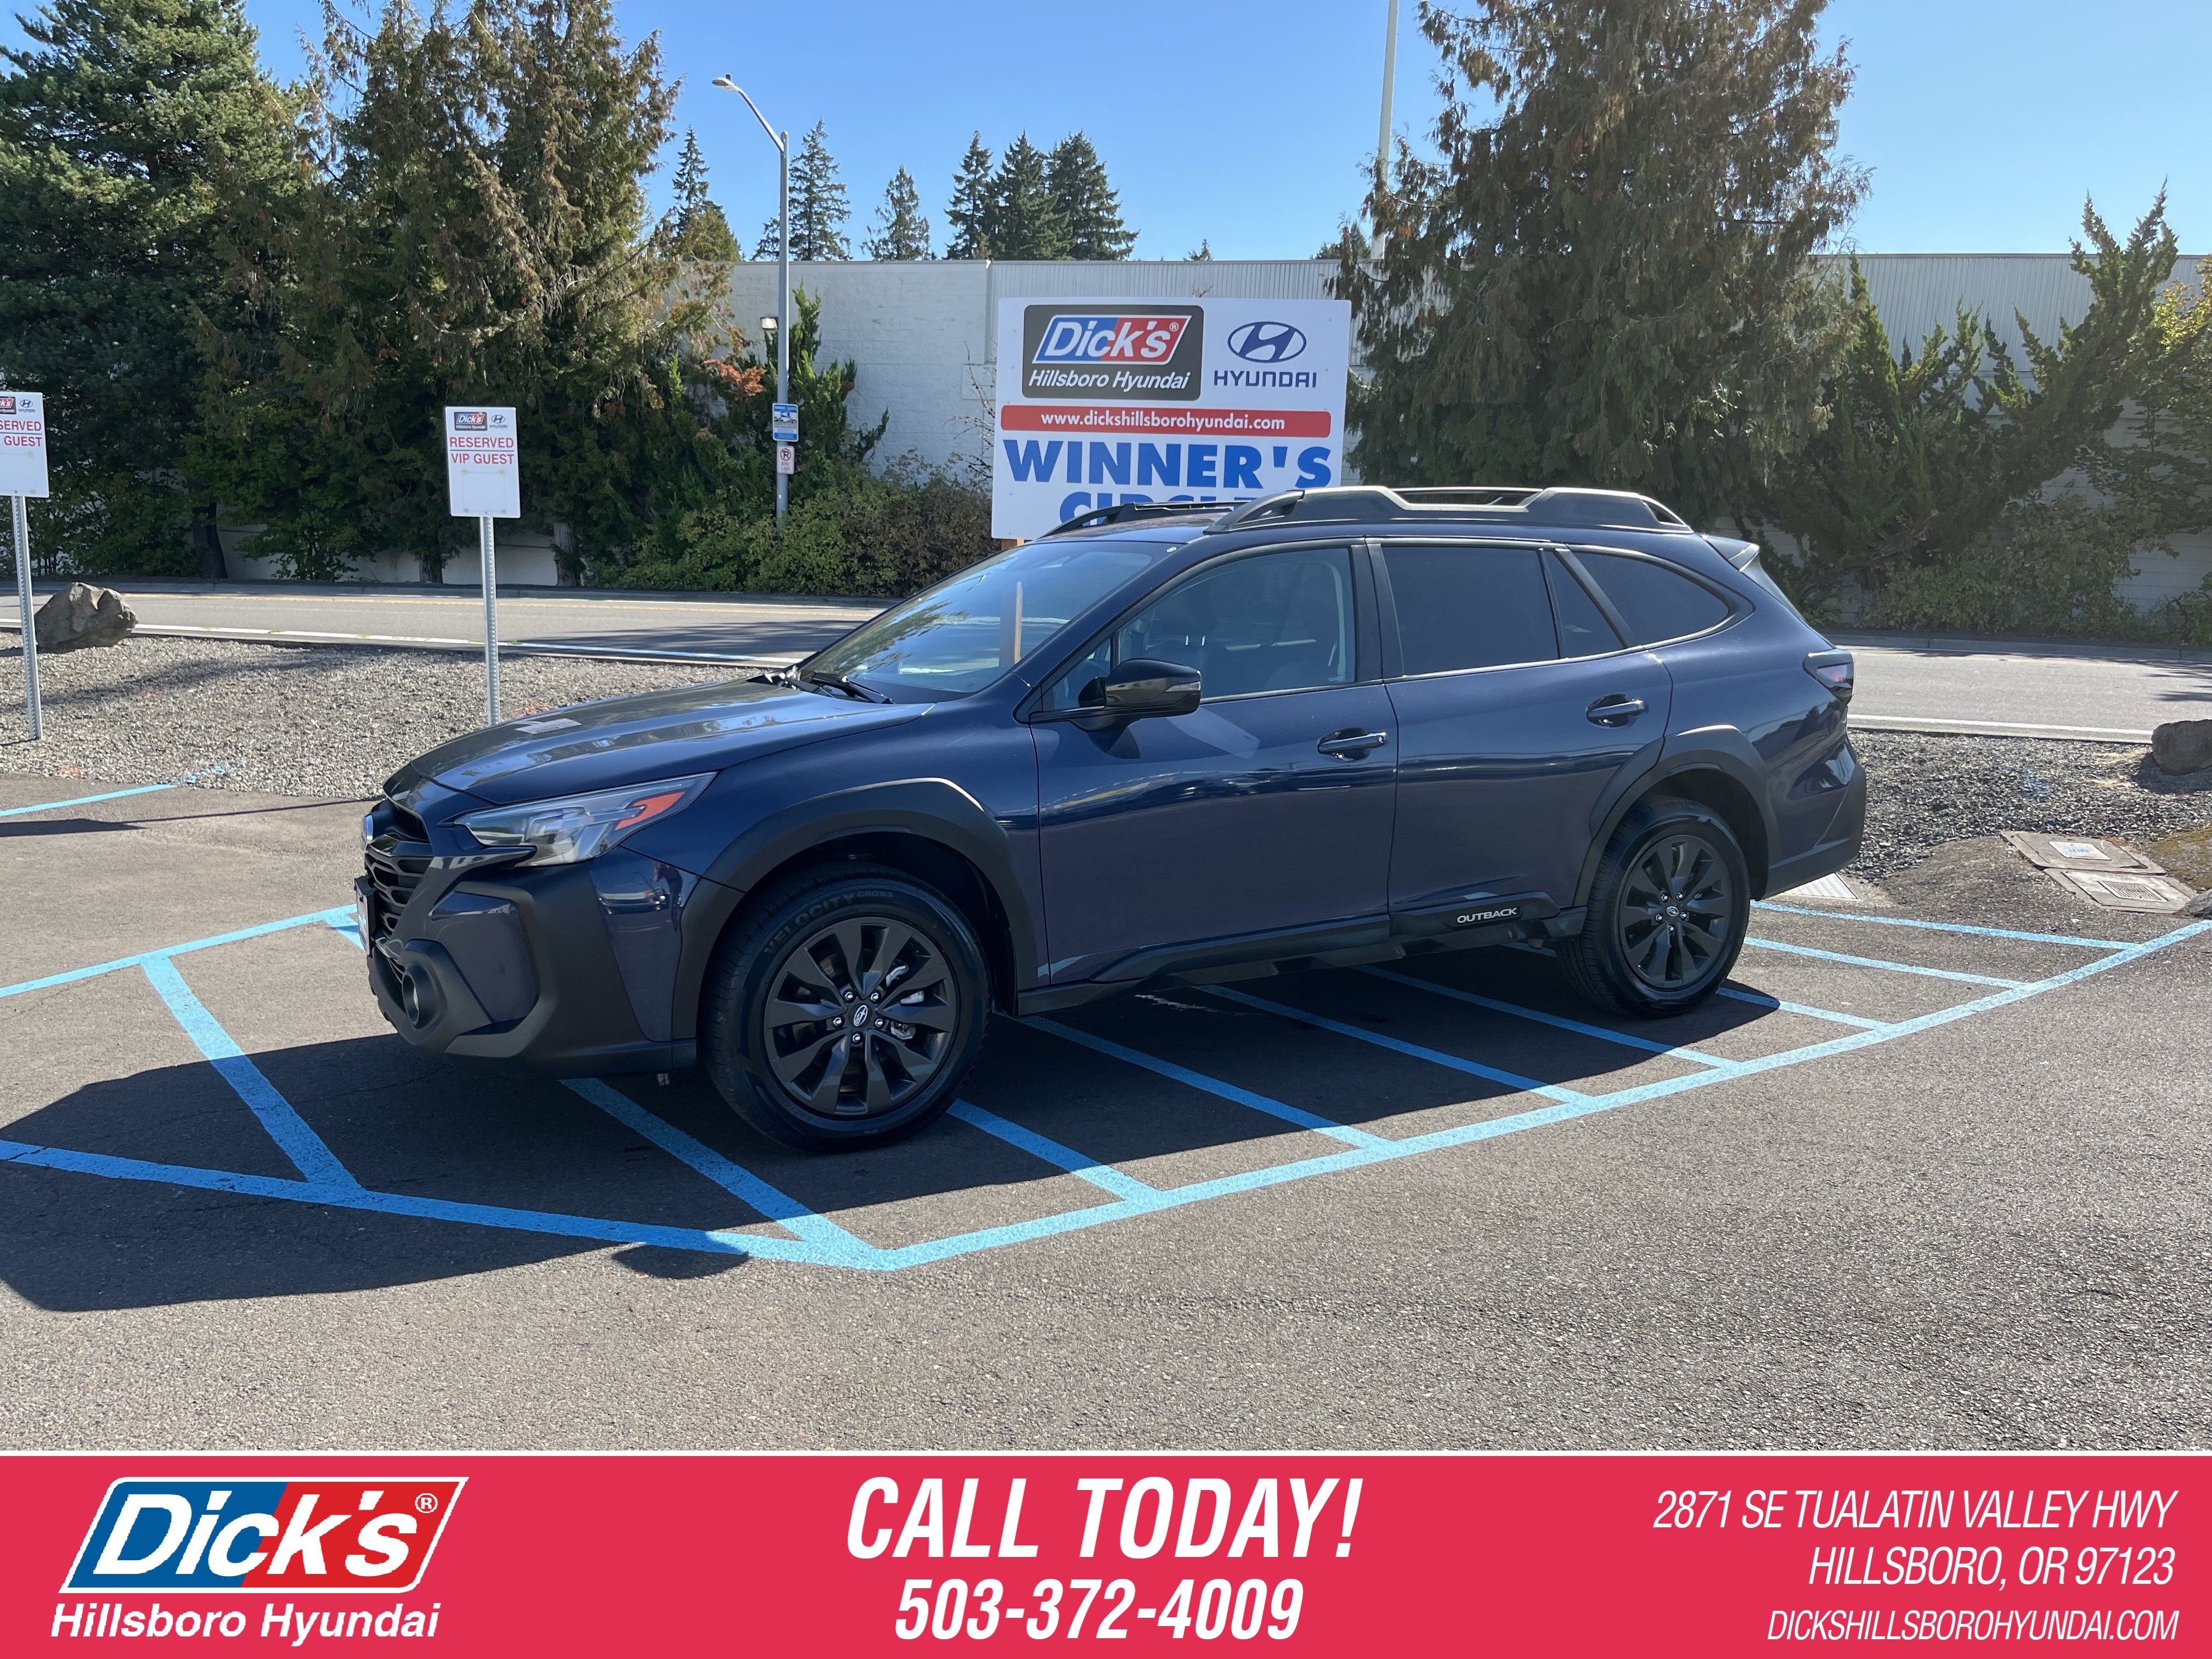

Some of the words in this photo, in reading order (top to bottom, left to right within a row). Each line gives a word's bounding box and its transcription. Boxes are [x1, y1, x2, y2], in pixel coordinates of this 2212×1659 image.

[1029, 370, 1109, 387] Hillsboro
[1112, 371, 1191, 392] Hyundai
[1214, 370, 1317, 388] HYUNDAI
[1041, 410, 1285, 430] www.dickshillsborohyundai.com
[4, 436, 42, 447] GUEST
[450, 437, 514, 448] RESERVED
[452, 453, 470, 464] VIP
[473, 454, 514, 464] GUEST
[1003, 439, 1331, 488] WINNER'S
[1457, 907, 1517, 923] OUTBACK
